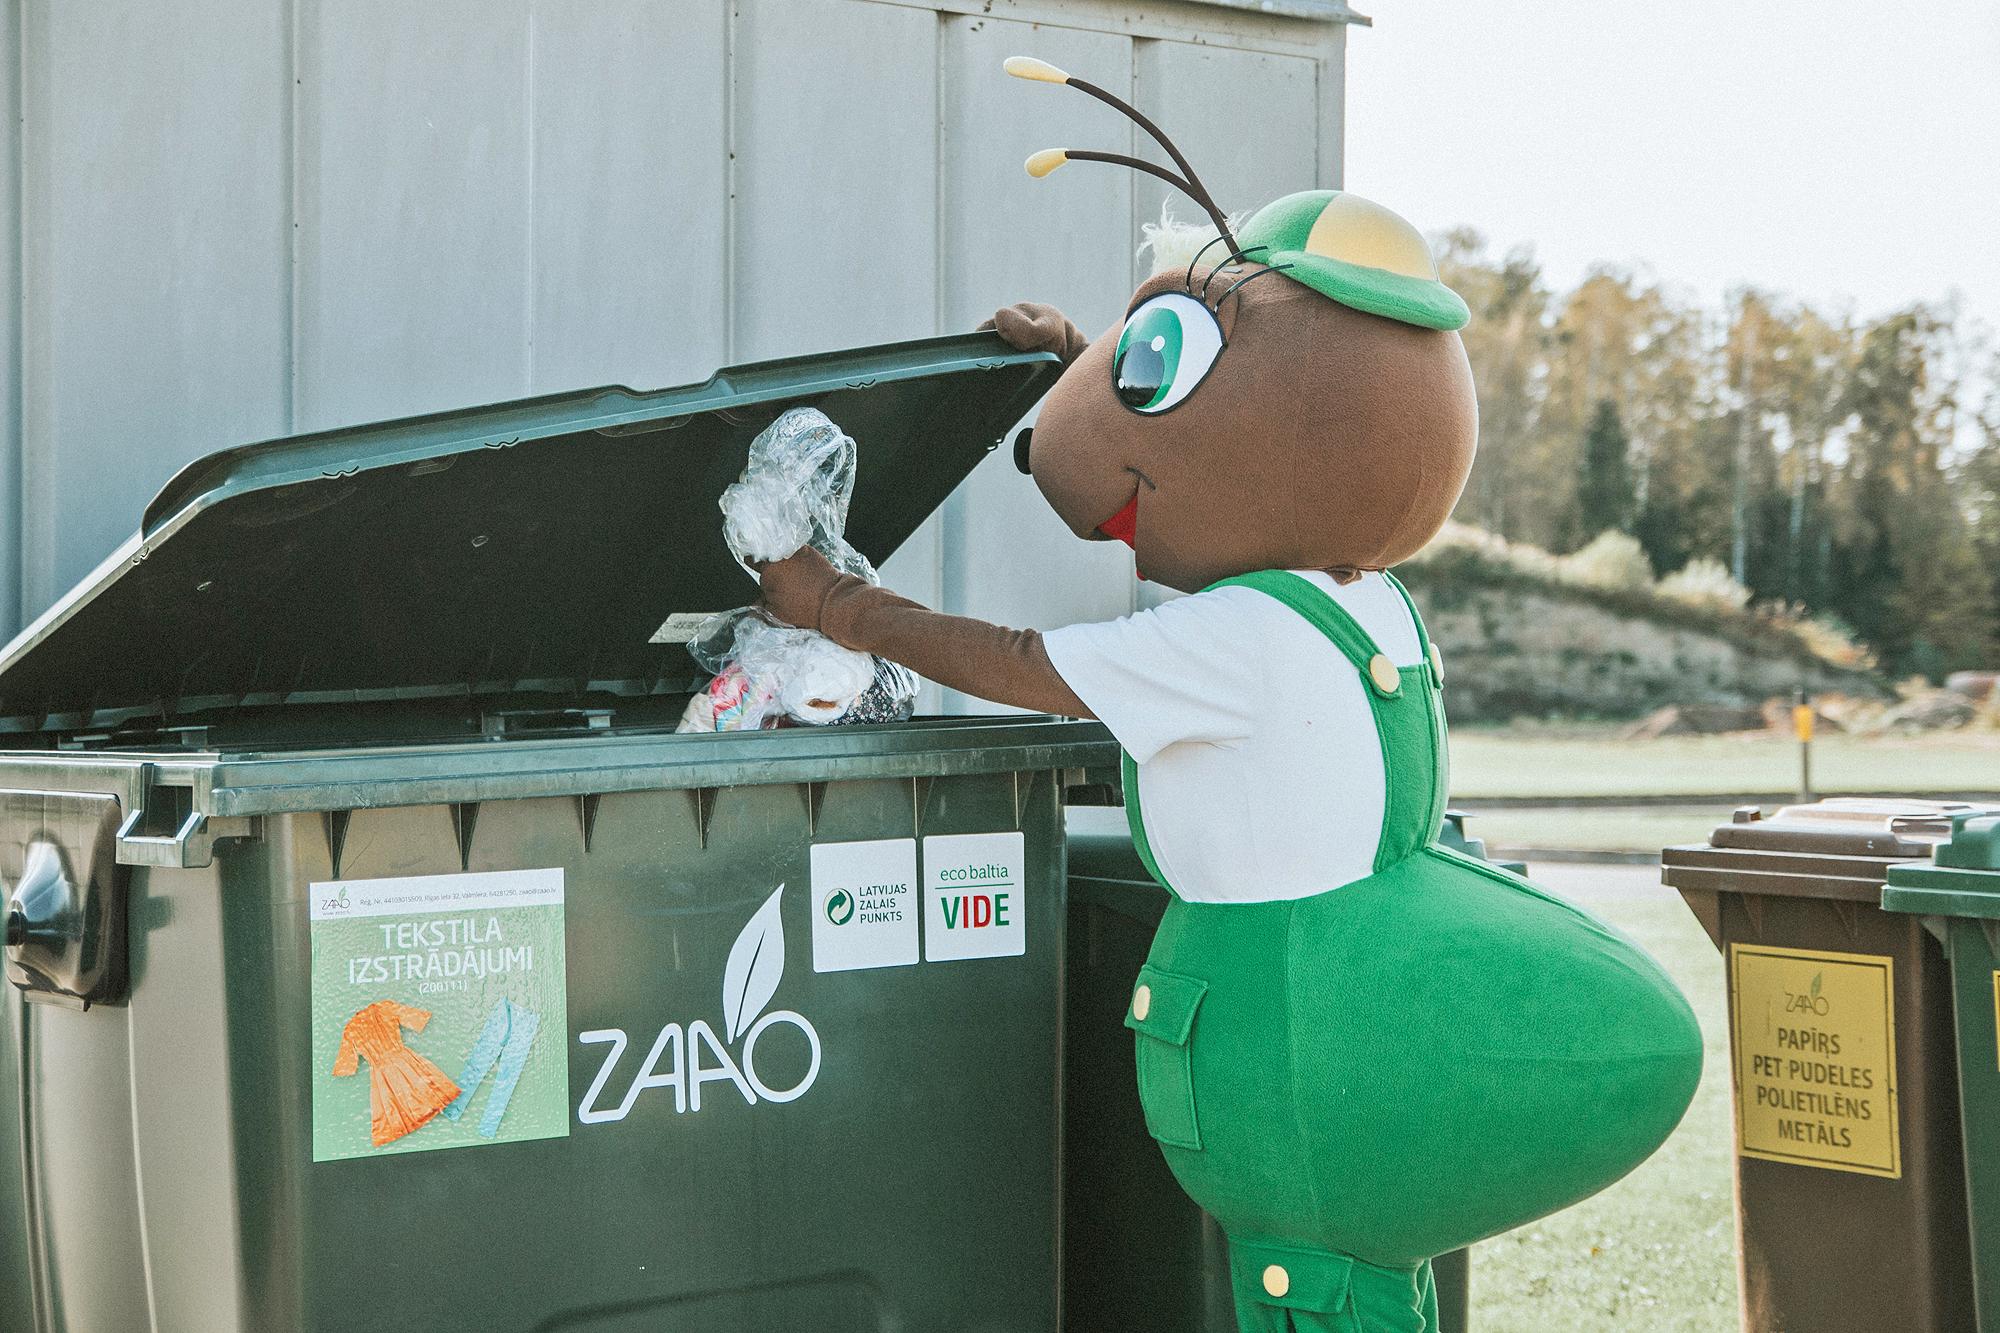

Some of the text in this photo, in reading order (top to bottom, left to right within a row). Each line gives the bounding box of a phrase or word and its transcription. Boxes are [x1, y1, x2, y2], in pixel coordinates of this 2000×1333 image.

[940, 864, 1009, 881] eco baltia
[859, 883, 907, 896] LATVIJAS
[322, 899, 350, 910] ZAAO
[859, 898, 896, 912] ZAĻAIS
[860, 911, 903, 924] PUNKTS
[941, 893, 1010, 930] VIDE
[380, 918, 502, 949] TEKSTILA
[350, 946, 532, 984] IZSTRĀDĀJUMI
[419, 980, 468, 995] (200111)
[1785, 992, 1830, 1016] ZAAO
[1778, 1028, 1841, 1054] PAPĪRS
[578, 1010, 821, 1125] ZAAO
[1754, 1055, 1873, 1089] PET PUDELES
[1758, 1086, 1872, 1120] POLIETILĒNS
[1778, 1119, 1851, 1148] METĀLS
